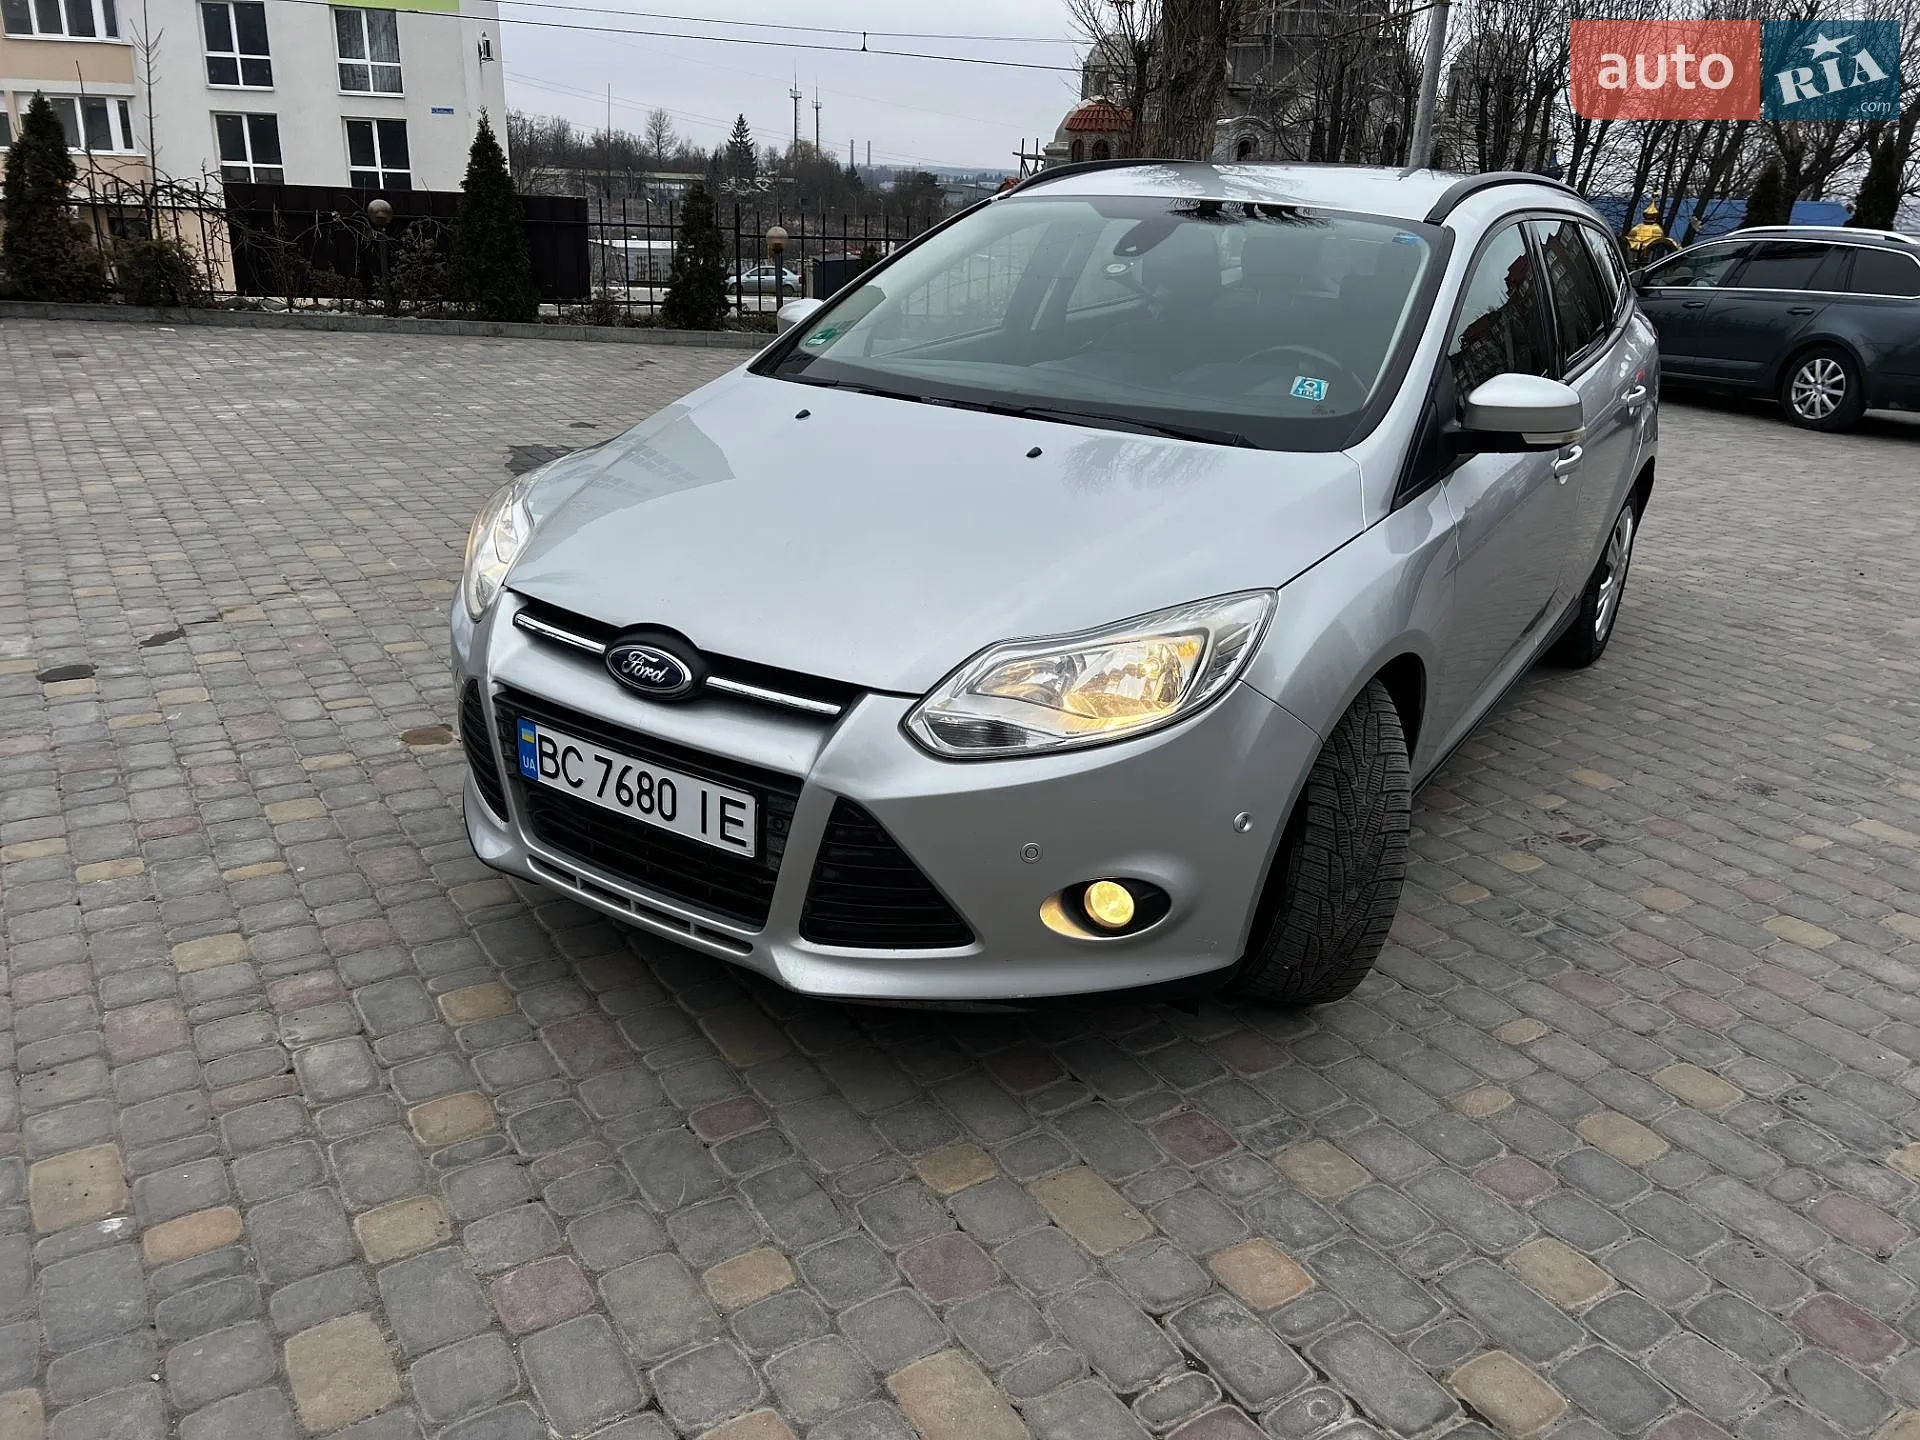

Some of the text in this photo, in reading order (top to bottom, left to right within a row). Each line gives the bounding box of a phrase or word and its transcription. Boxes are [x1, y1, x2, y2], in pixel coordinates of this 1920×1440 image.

[621, 651, 668, 684] Ford
[522, 755, 536, 772] UA
[537, 733, 747, 848] BC 7680 IE
